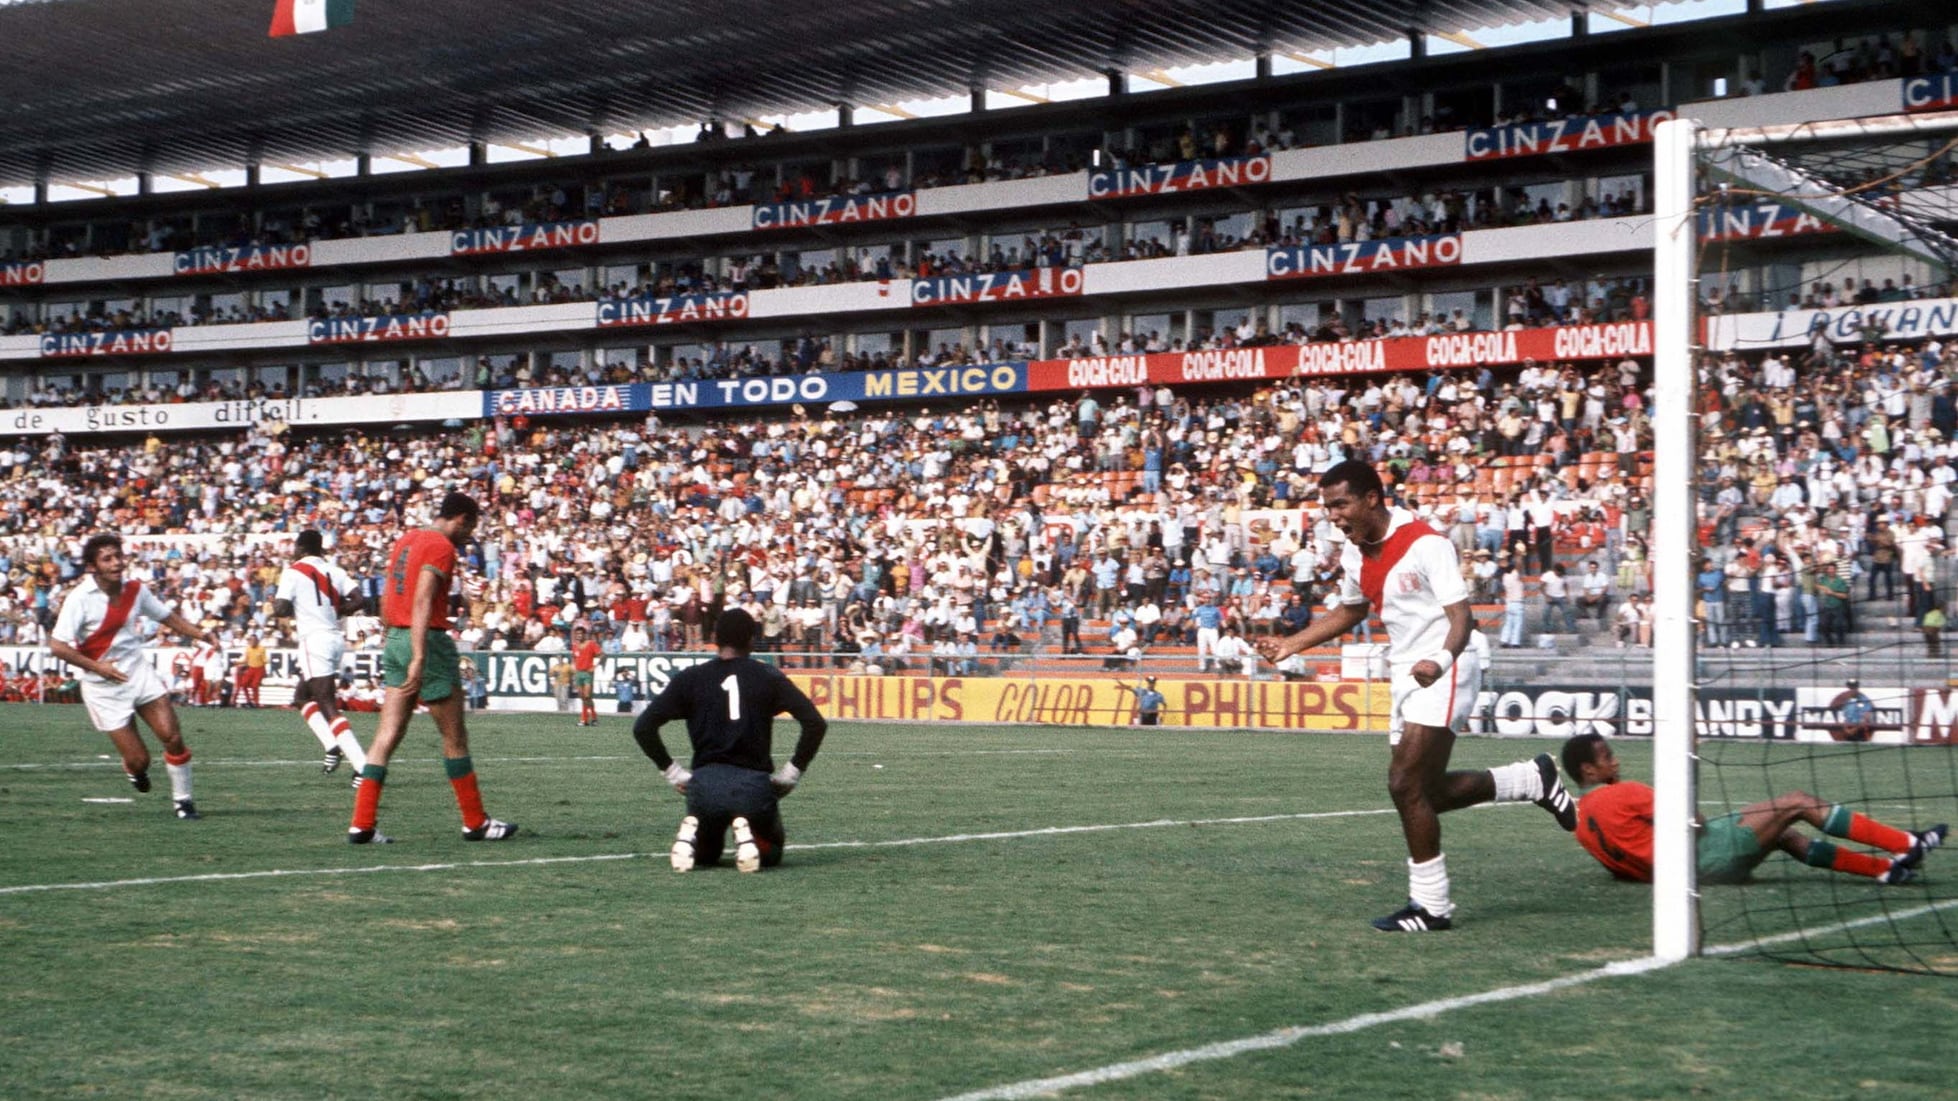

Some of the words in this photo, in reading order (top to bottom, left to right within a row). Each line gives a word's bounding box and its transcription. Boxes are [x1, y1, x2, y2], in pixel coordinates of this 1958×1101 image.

[1090, 158, 1270, 197] CINZANO
[755, 193, 915, 226] CINZANO
[1707, 205, 1822, 239] INZA
[453, 222, 598, 250] CINZANO
[175, 244, 310, 273] CINZANO
[1269, 236, 1460, 275] CINZANO
[913, 269, 1082, 303] CINZAO
[599, 294, 748, 324] CINZANO
[41, 331, 171, 356] CINZANO
[311, 315, 449, 342] CINZANO
[1555, 323, 1650, 358] COCA-COLA
[1182, 349, 1266, 381] COCA-COLA
[1298, 341, 1385, 374] COCA-COLA
[1427, 332, 1517, 367] COCA-COLA
[1068, 356, 1148, 386] COCA-COLA
[498, 386, 620, 413] CANADA
[652, 383, 697, 407] EN
[718, 377, 827, 403] TODO
[865, 366, 1017, 398] MEXICO
[14, 412, 43, 429] de
[87, 407, 169, 430] gusto
[311, 571, 338, 607] 11
[722, 675, 740, 720] 1
[809, 677, 963, 721] PHILIPS
[995, 682, 1094, 724] COLOR
[1185, 682, 1359, 730] PHILIPS
